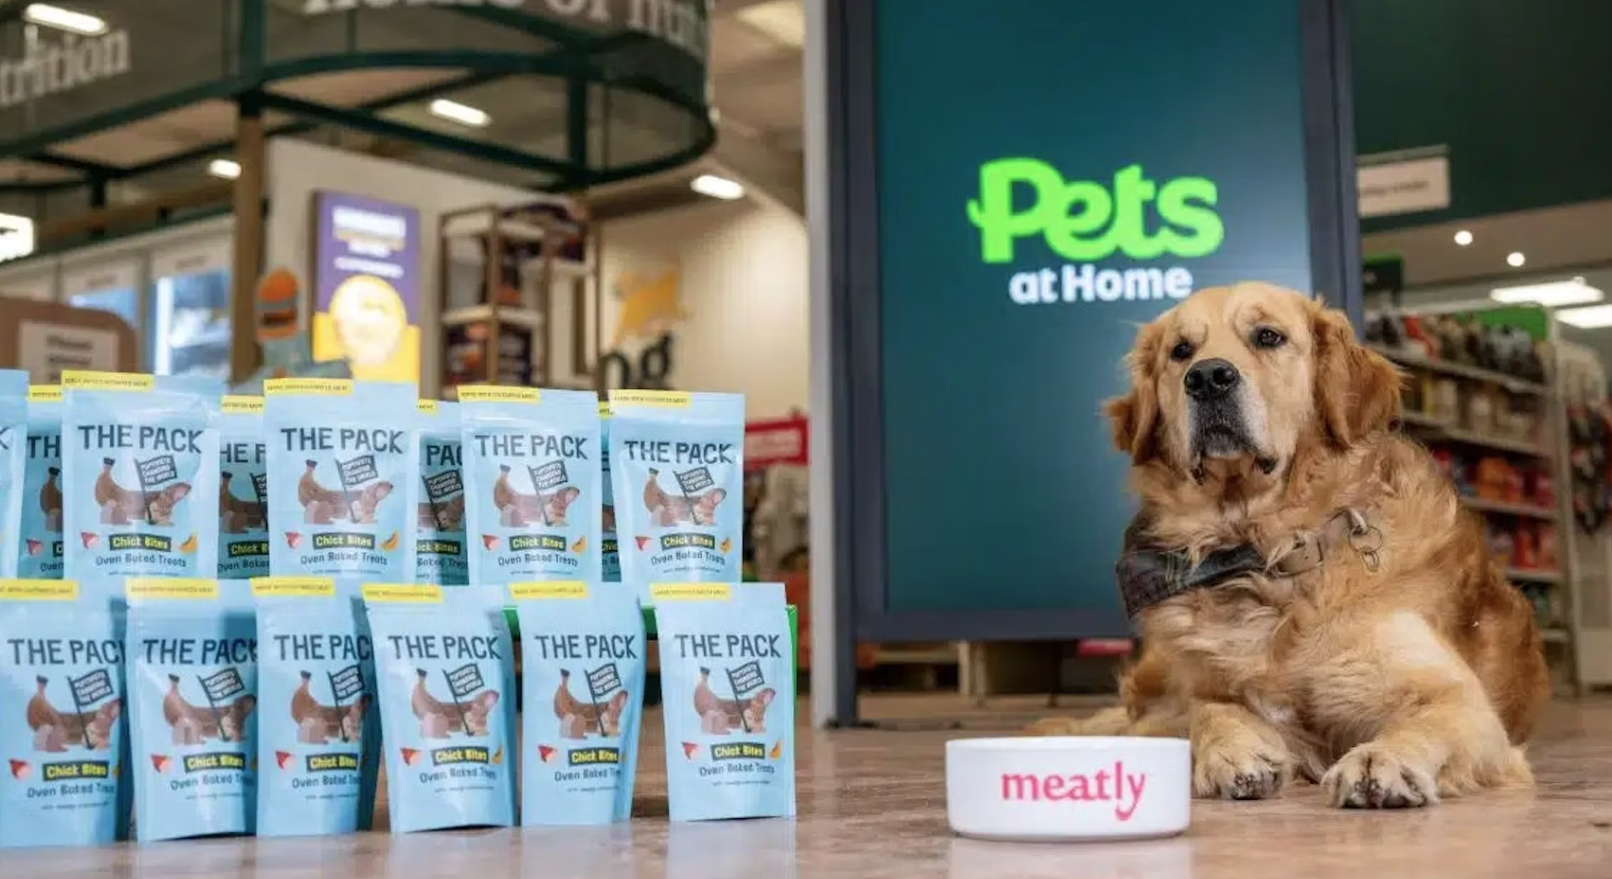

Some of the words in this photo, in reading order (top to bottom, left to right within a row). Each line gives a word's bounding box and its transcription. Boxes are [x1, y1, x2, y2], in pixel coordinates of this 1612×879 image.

[966, 157, 1225, 263] Pets
[1009, 267, 1058, 304] at
[1061, 264, 1194, 301] Home
[27, 435, 61, 459] TH
[78, 425, 133, 450] THE
[139, 428, 205, 454] PACK
[281, 427, 333, 451] THE
[340, 428, 405, 454] PACK
[475, 434, 524, 457] THE
[531, 435, 588, 460] PACK
[219, 443, 249, 463] HE
[624, 440, 670, 463] THE
[676, 442, 733, 465] PACK
[112, 535, 143, 548] Chick
[144, 536, 170, 550] Bites
[316, 535, 344, 548] Chick
[347, 535, 372, 548] Bites
[512, 537, 539, 549] Chick
[542, 537, 564, 549] Bites
[664, 536, 688, 548] Chick
[96, 555, 122, 566] Oven
[124, 553, 155, 565] Baked
[158, 554, 187, 568] Treats
[300, 553, 325, 565] Oven
[328, 551, 358, 563] Baked
[361, 552, 388, 566] Treats
[498, 555, 522, 566] Oven
[525, 553, 551, 564] Baked
[555, 554, 578, 567] Treats
[651, 555, 673, 566] Oven
[705, 552, 725, 566] Treats
[7, 639, 64, 665] THE
[142, 639, 195, 665] THE
[274, 635, 324, 660] THE
[330, 635, 373, 660] PAC
[388, 635, 440, 660] THE
[443, 636, 502, 660] PACK
[535, 635, 582, 660] THE
[586, 635, 637, 660] PACK
[674, 635, 723, 658] THE
[726, 635, 782, 659] PACK
[435, 750, 464, 762] Chick
[466, 749, 488, 761] Bites
[571, 752, 596, 763] Chick
[714, 745, 739, 757] Chick
[743, 744, 763, 756] Bites
[187, 757, 217, 769] Chick
[220, 755, 243, 767] Bites
[309, 756, 337, 768] Chick
[47, 766, 78, 778] Chick
[82, 763, 107, 776] Bites
[419, 771, 447, 784] Oven
[450, 768, 477, 779] Baked
[554, 771, 580, 782] Oven
[700, 766, 725, 777] Oven
[727, 763, 753, 774] Baked
[170, 779, 198, 791] Oven
[203, 775, 233, 786] Baked
[292, 778, 319, 789] Oven
[322, 776, 346, 787] Baked
[27, 787, 56, 798] Oven
[61, 784, 93, 796] Baked
[1001, 761, 1146, 821] meatly
